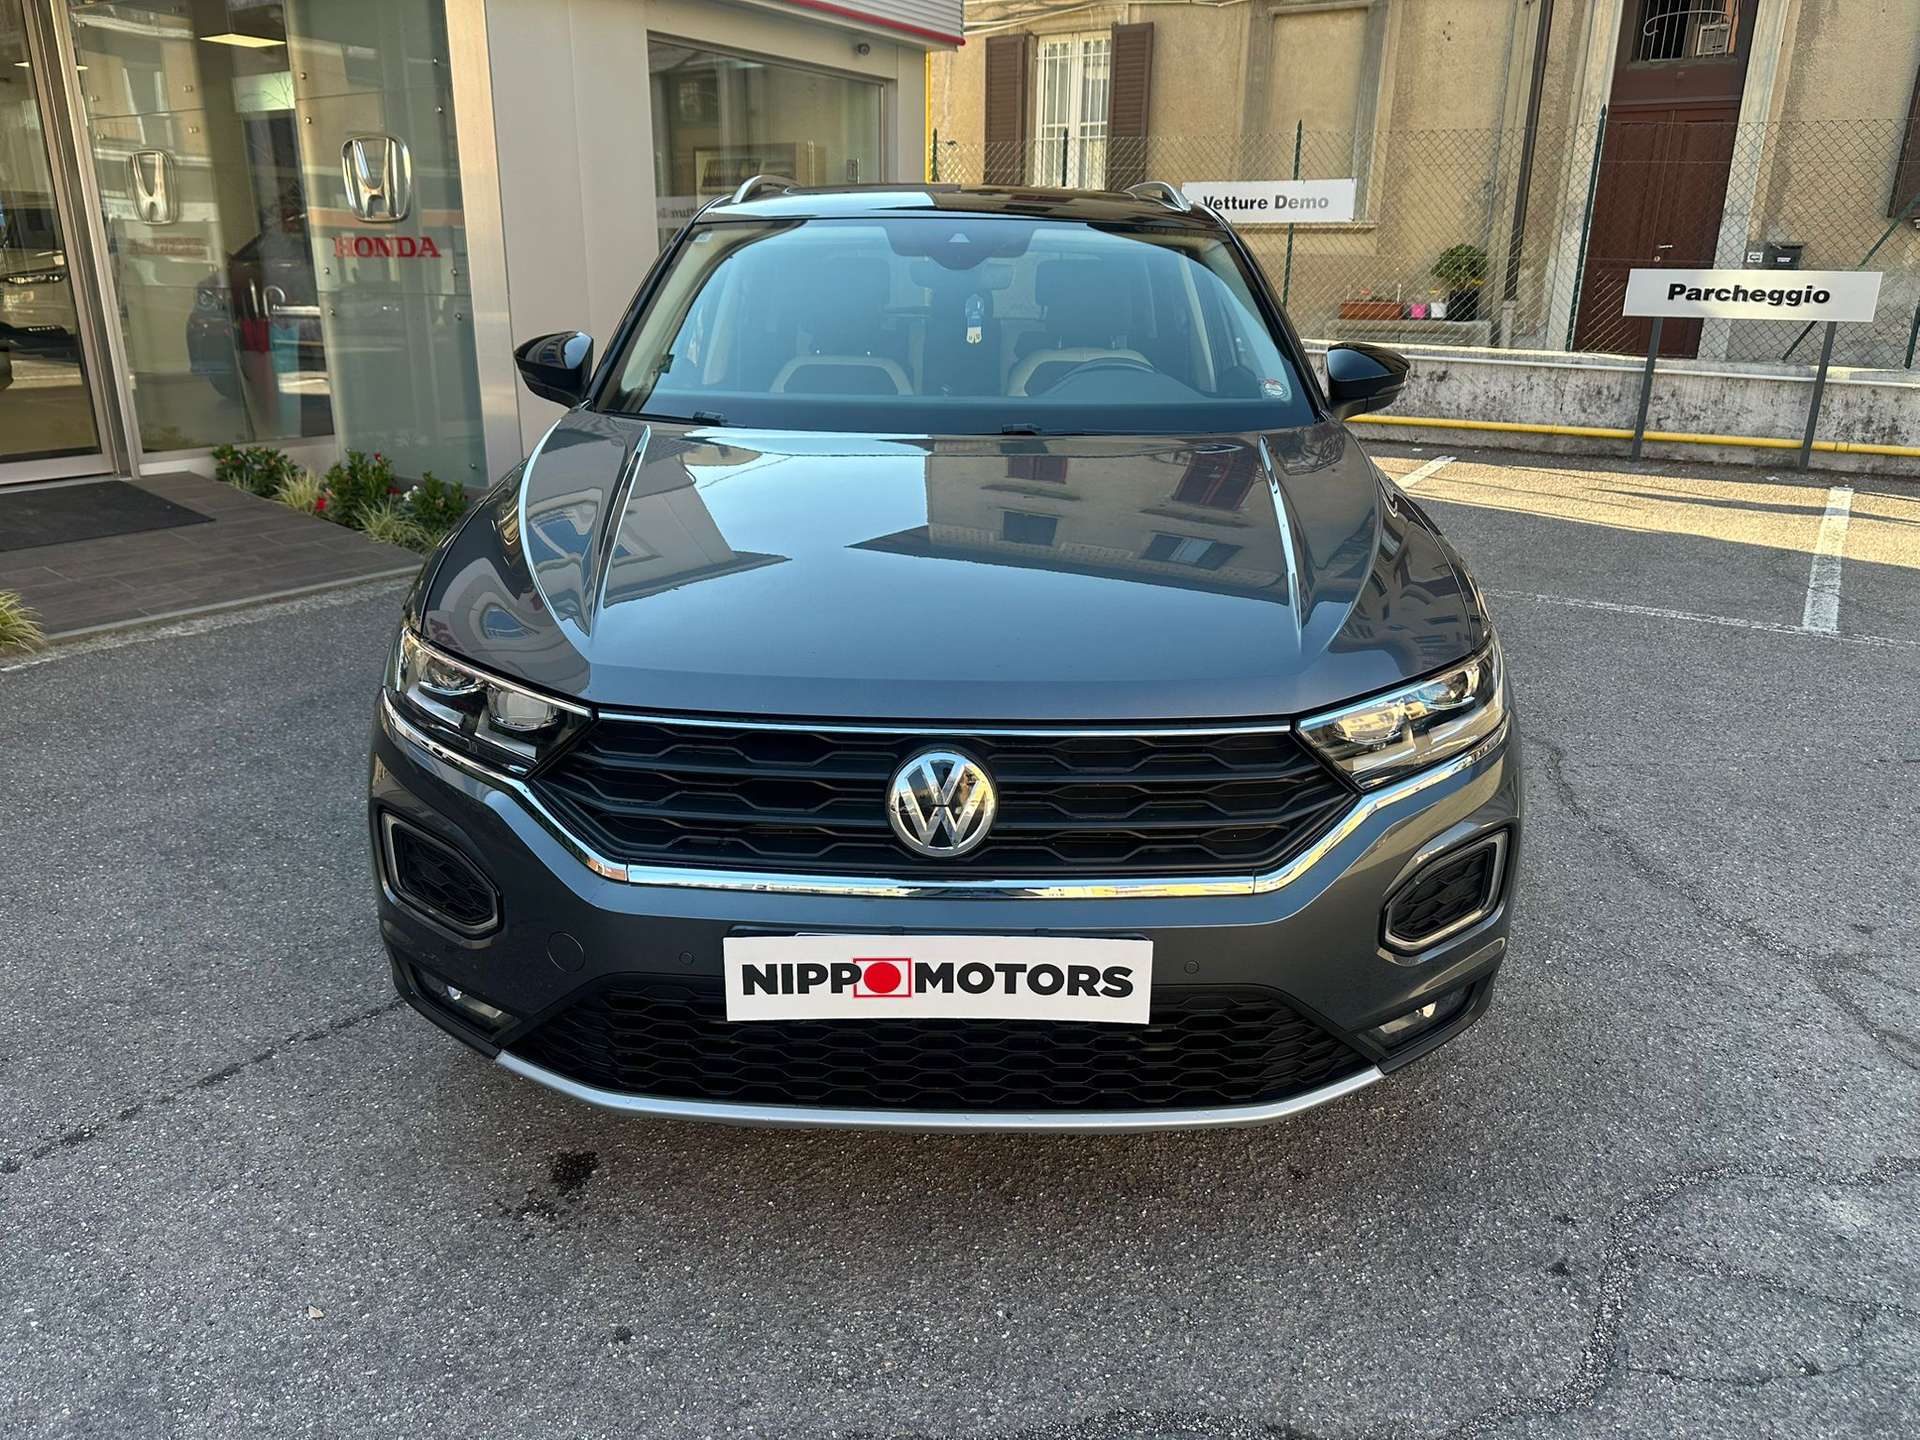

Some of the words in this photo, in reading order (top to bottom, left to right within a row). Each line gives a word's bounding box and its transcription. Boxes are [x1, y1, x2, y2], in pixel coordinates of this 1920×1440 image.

[1203, 196, 1269, 210] Vetture
[1274, 195, 1329, 209] Demo
[331, 236, 442, 258] HONDA
[1667, 283, 1831, 307] Parcheggio
